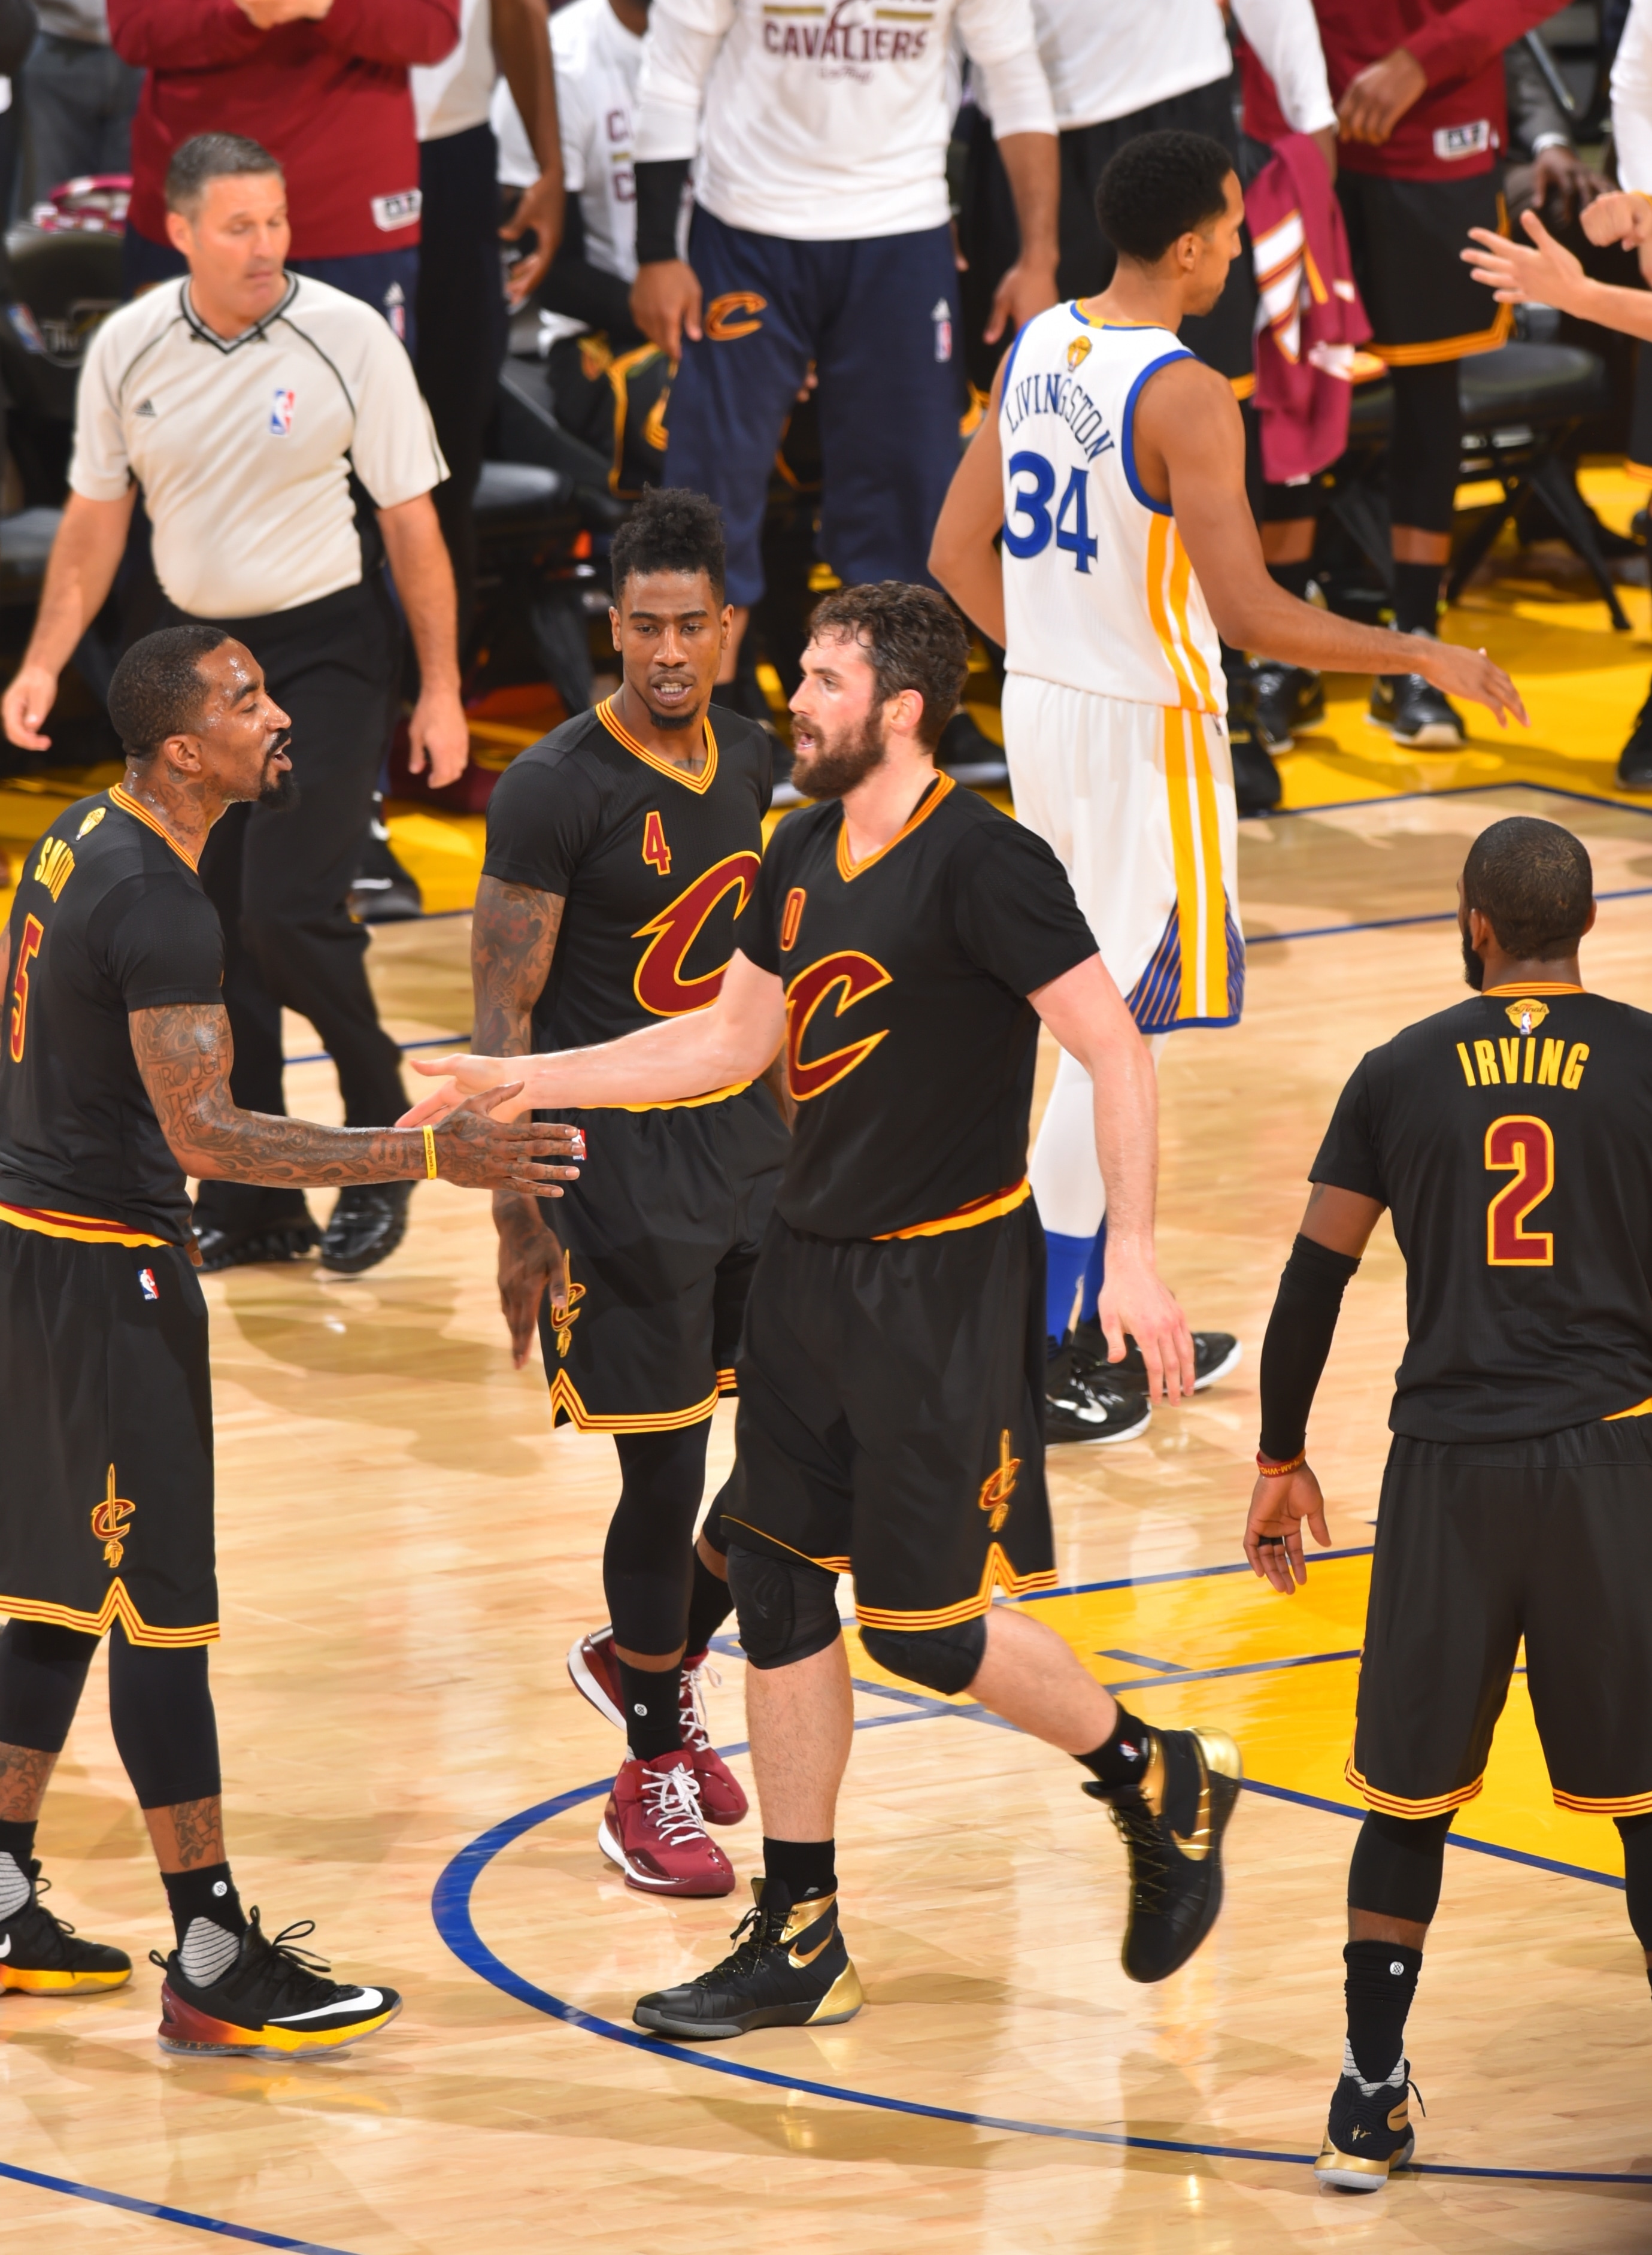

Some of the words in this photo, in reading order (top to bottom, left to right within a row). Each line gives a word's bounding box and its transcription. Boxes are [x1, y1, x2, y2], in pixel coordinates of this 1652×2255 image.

[763, 21, 927, 61] CAVALIERS
[1006, 374, 1115, 462] LIVINGSTON
[1003, 450, 1098, 575] 34
[642, 810, 672, 875] 4
[780, 887, 807, 951] 0
[10, 912, 44, 1063] 5
[785, 950, 893, 1101] C
[165, 1081, 203, 1117] THE
[1456, 1036, 1590, 1090] IRVING
[1484, 1114, 1554, 1266] 2
